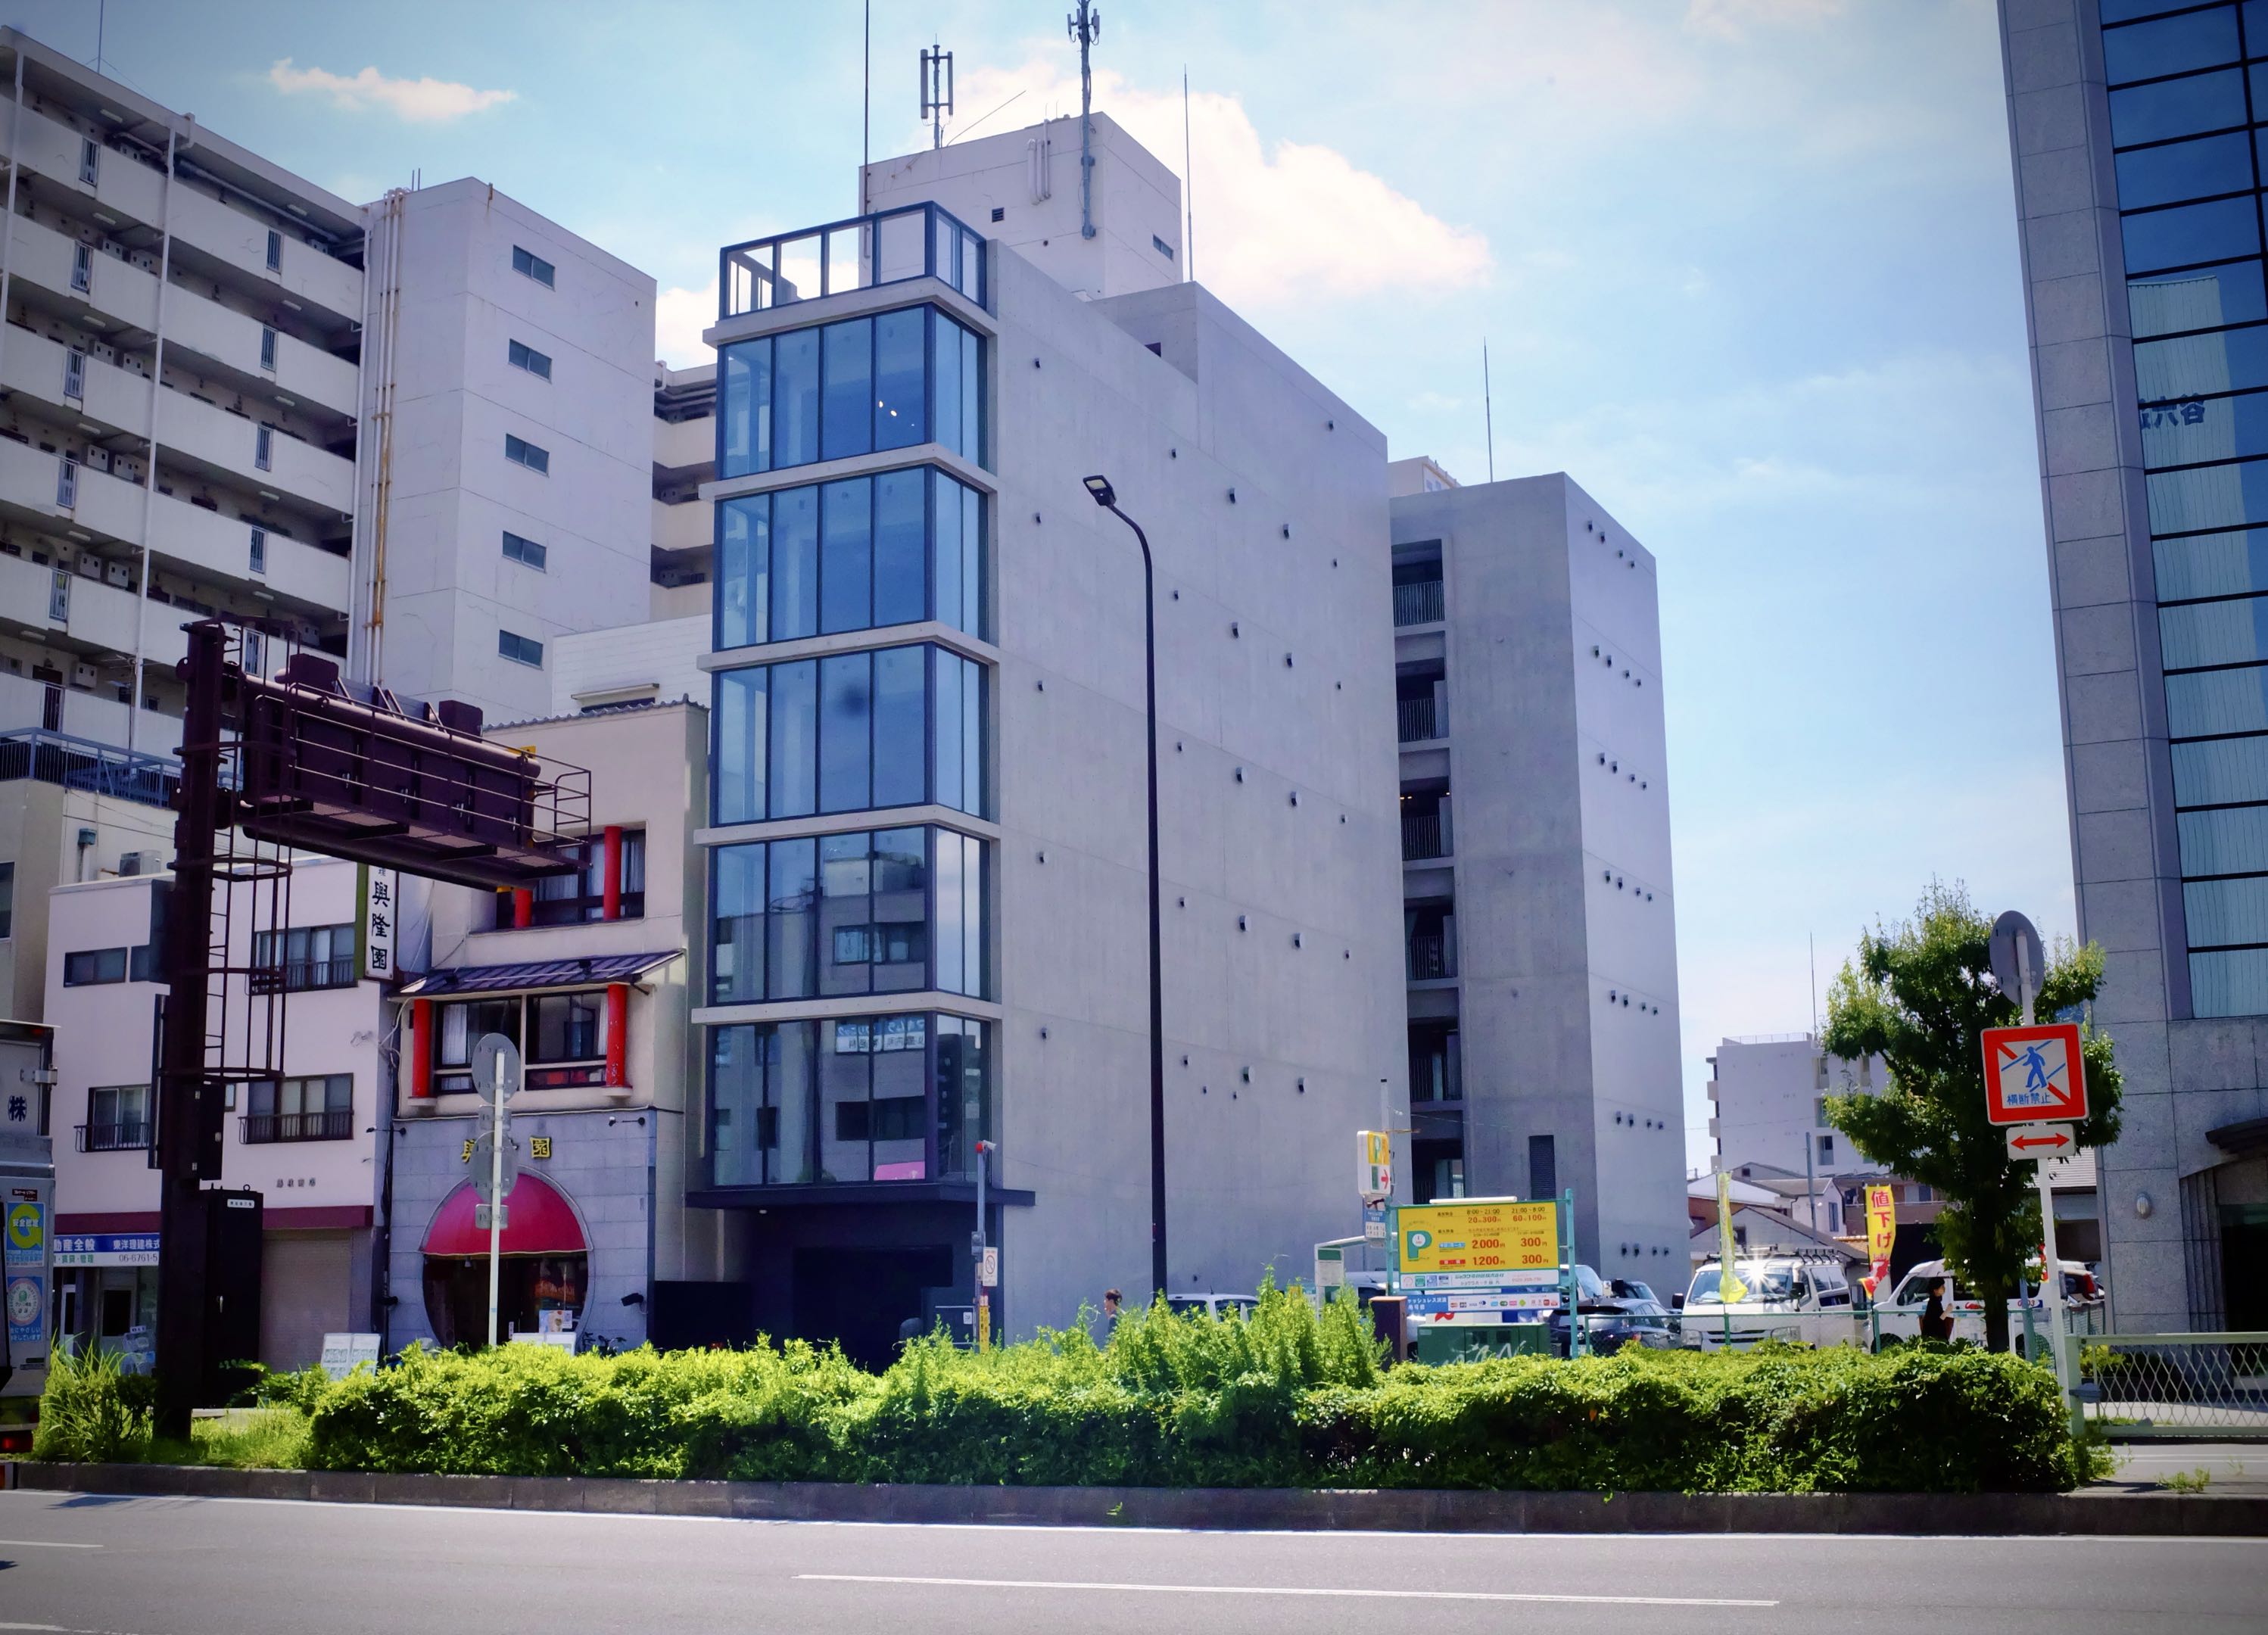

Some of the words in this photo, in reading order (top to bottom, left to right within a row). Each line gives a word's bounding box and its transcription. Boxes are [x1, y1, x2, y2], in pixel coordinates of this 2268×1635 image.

[2007, 1092, 2051, 1105] 横断禁止
[1871, 1190, 1892, 1249] 値下げ
